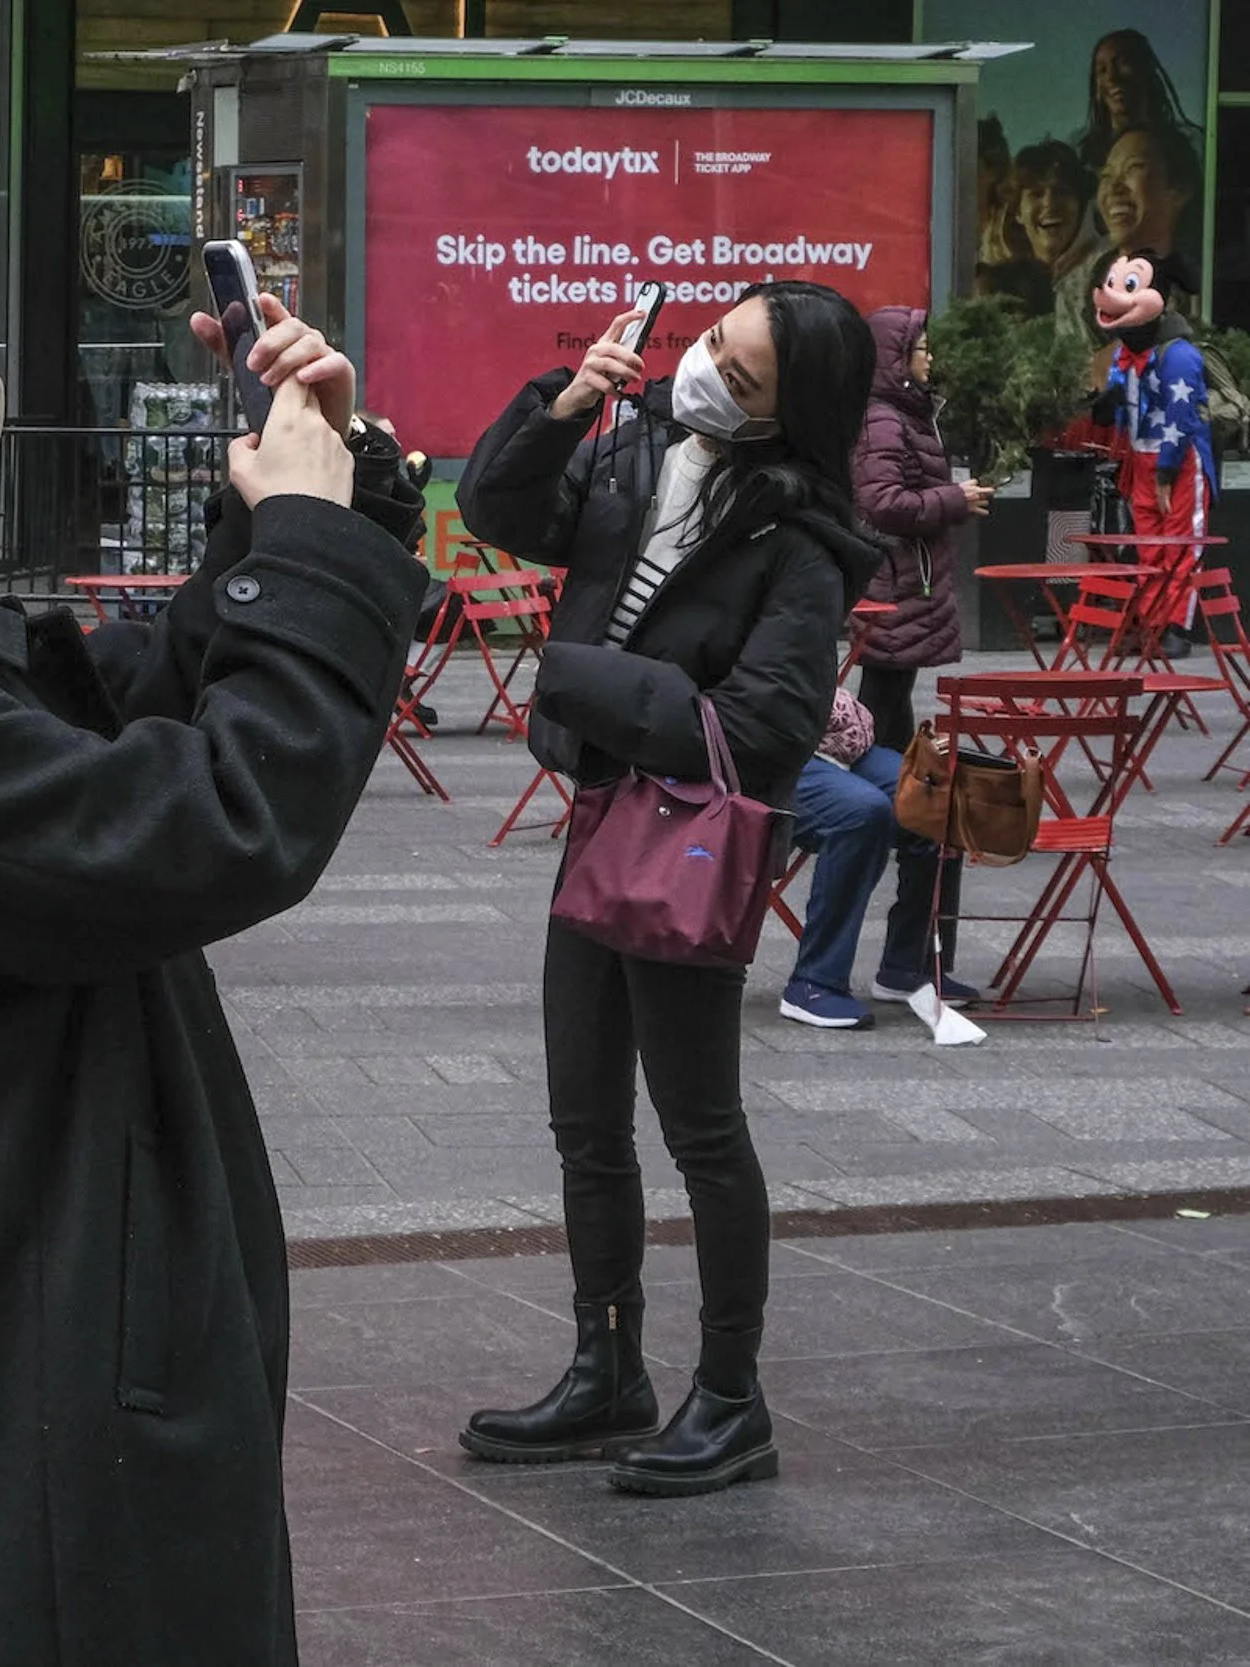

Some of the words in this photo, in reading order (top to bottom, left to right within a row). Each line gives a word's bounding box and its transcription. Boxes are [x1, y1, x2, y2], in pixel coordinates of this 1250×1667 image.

[615, 90, 691, 105] JCDecaux
[527, 147, 660, 180] todaytix
[695, 152, 714, 162] THE
[716, 152, 772, 162] BROADWAY
[695, 163, 729, 173] TICKET
[731, 163, 752, 173] APP
[436, 234, 507, 271] Skip
[512, 236, 566, 265] the
[573, 235, 640, 265] line.
[648, 235, 706, 265] Get
[712, 236, 873, 270] Broadway
[102, 264, 178, 298] EAGLE
[509, 273, 617, 303] tickets
[663, 273, 774, 303] secon
[667, 332, 698, 350] fro
